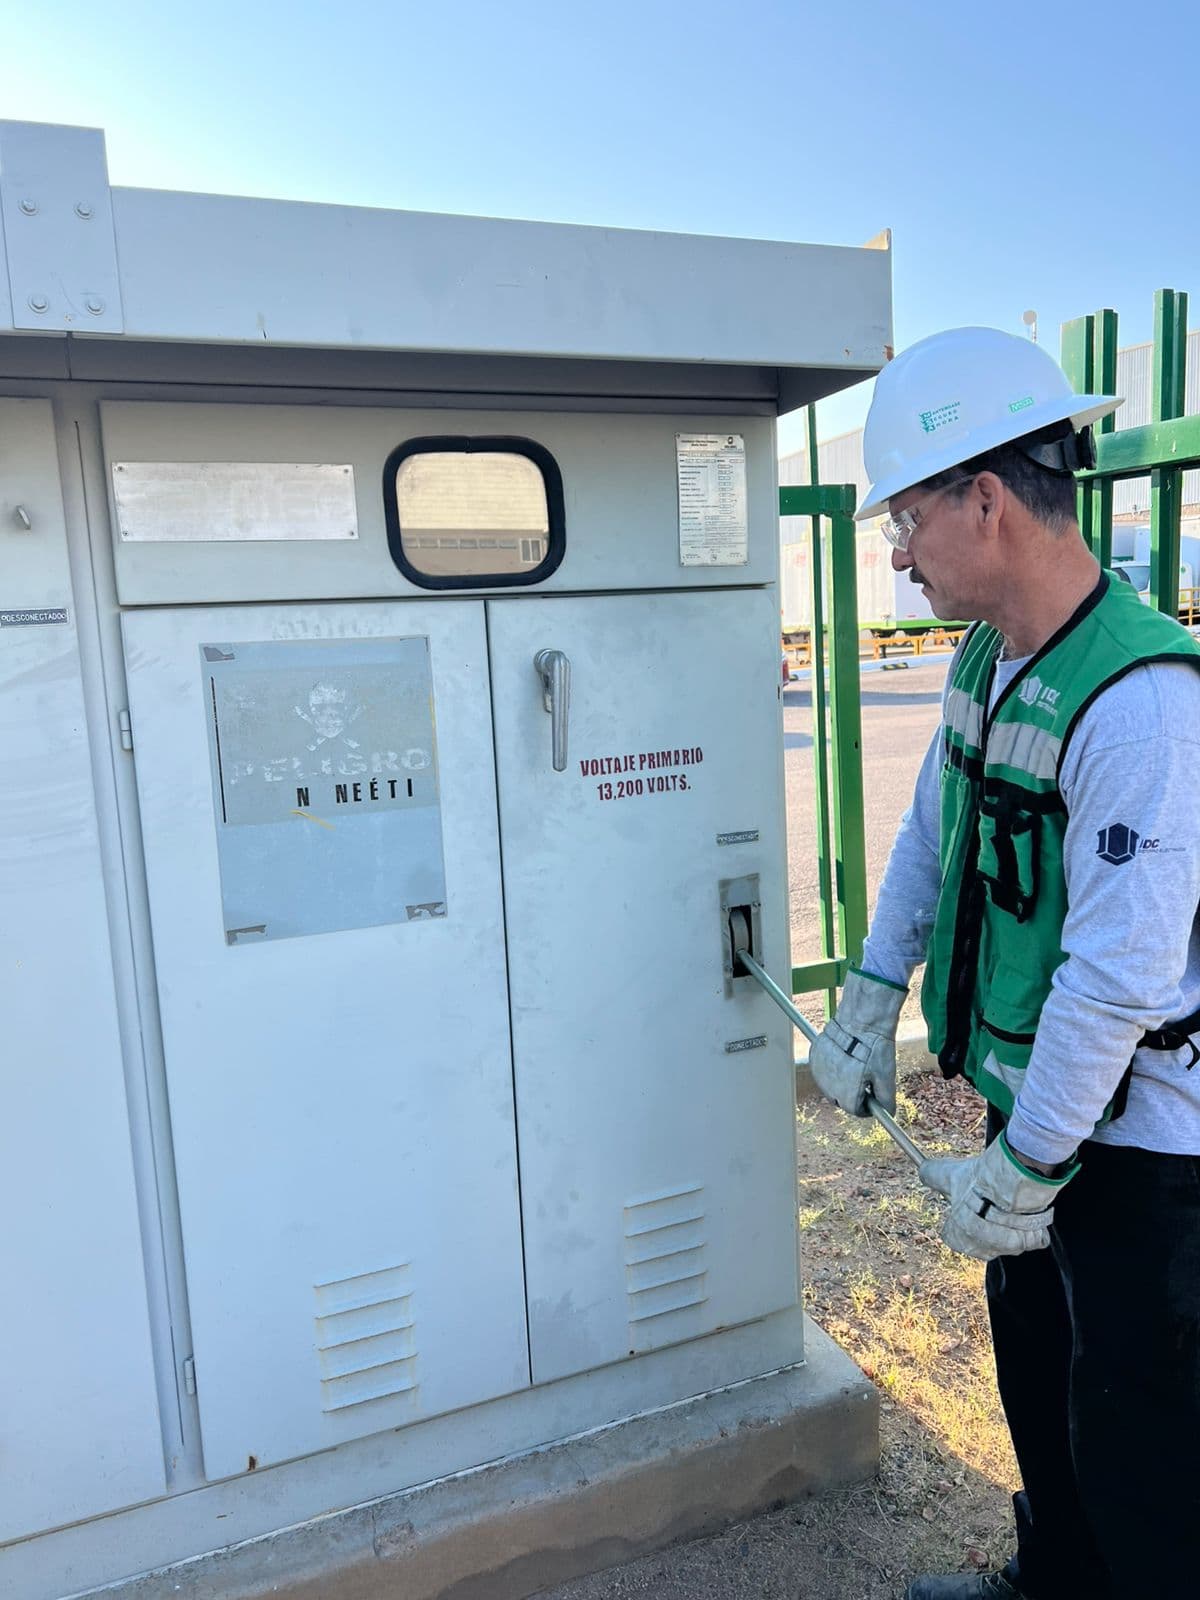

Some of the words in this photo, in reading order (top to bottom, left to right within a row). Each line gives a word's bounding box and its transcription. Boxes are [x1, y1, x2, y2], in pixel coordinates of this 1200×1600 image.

[580, 755, 636, 777] VOLTAJE
[638, 747, 704, 771] PRIMARIO
[597, 779, 643, 801] 13,200
[647, 774, 692, 793] VOLTS.
[1139, 838, 1160, 849] IDC
